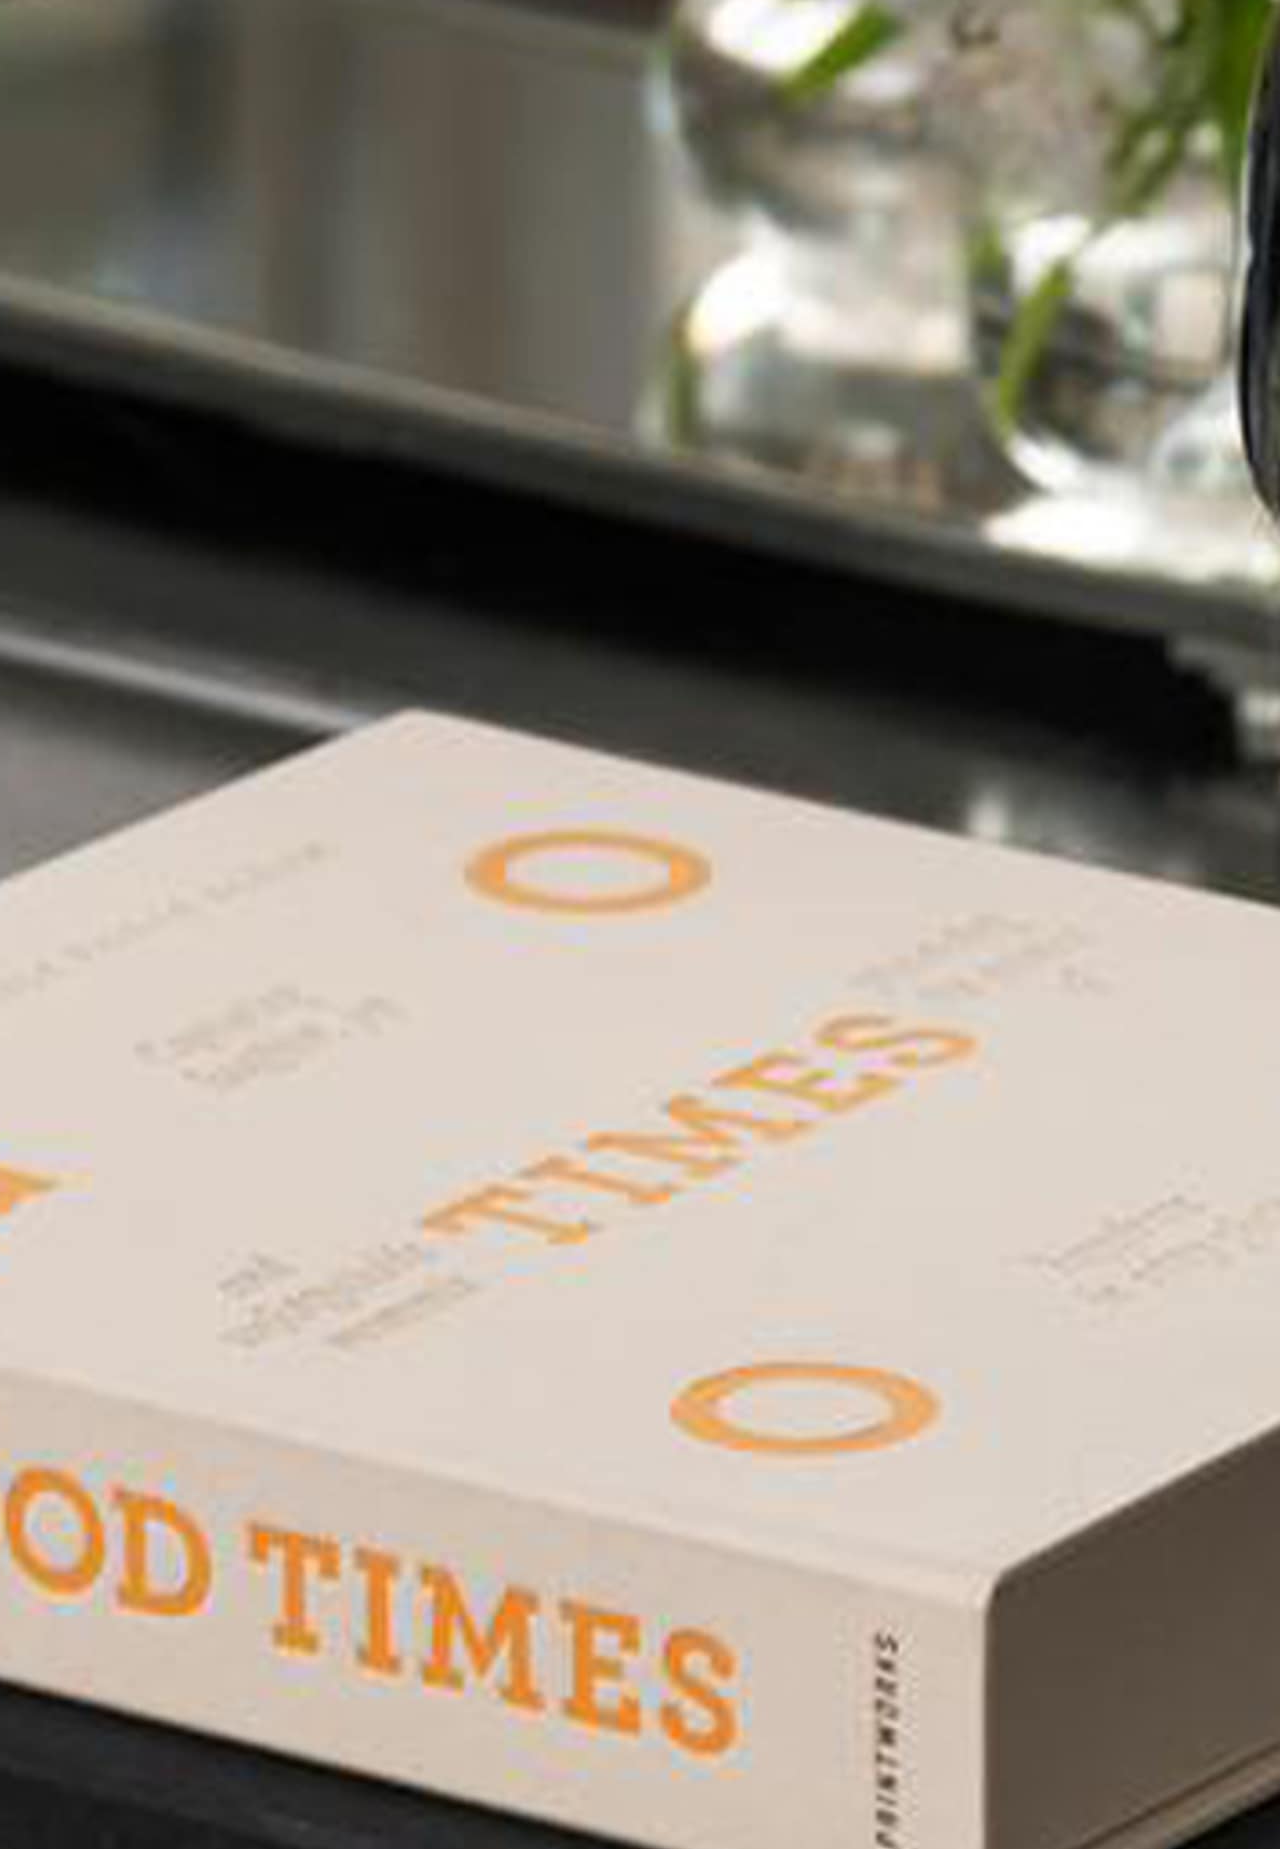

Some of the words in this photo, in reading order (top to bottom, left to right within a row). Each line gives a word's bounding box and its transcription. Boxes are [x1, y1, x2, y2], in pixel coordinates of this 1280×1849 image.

[464, 828, 714, 918] O
[421, 1010, 980, 1248] TIMES
[670, 1360, 940, 1457] O
[246, 1524, 744, 1762] TIMES
